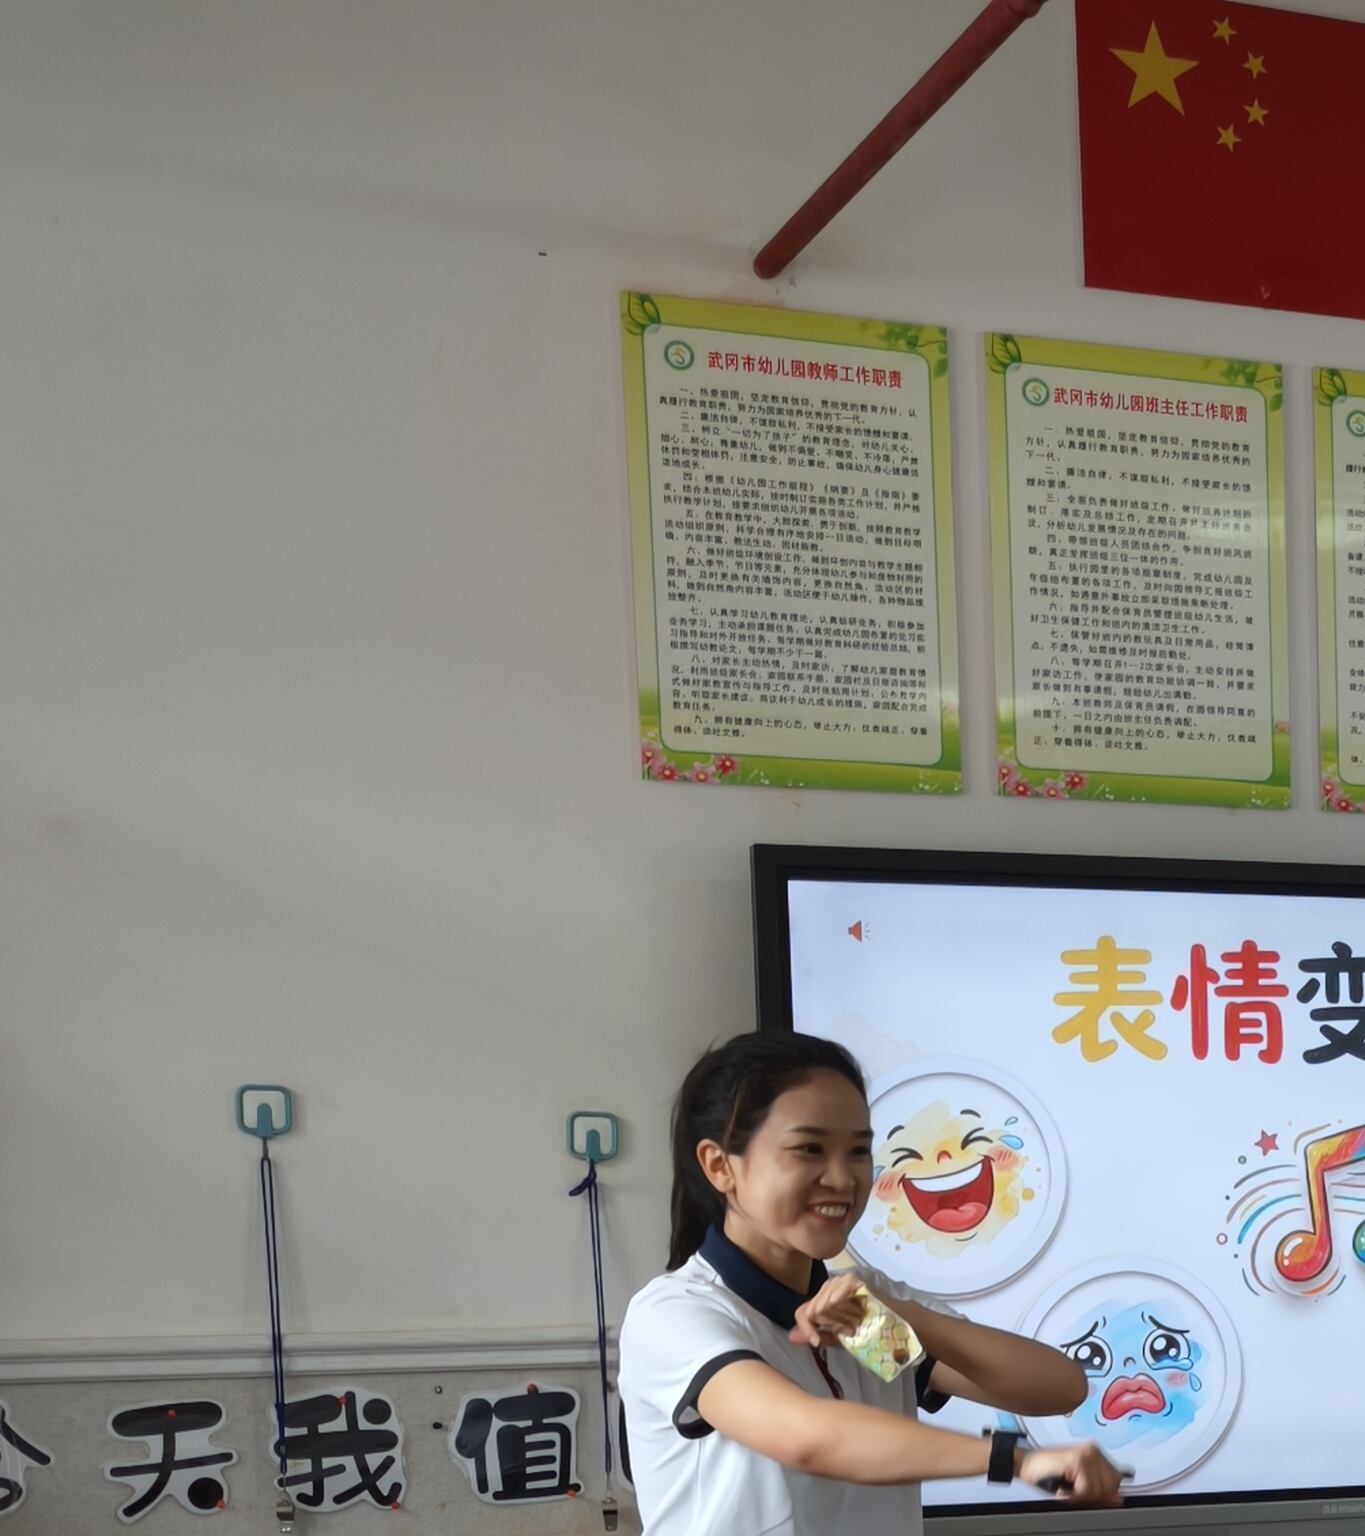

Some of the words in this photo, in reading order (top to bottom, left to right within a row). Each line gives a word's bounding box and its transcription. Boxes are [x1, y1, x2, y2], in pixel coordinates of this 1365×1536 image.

[707, 350, 901, 388] 武冈市幼儿园教师工作职责
[1053, 387, 1247, 422] 武冈市幼儿园班主任工作职责
